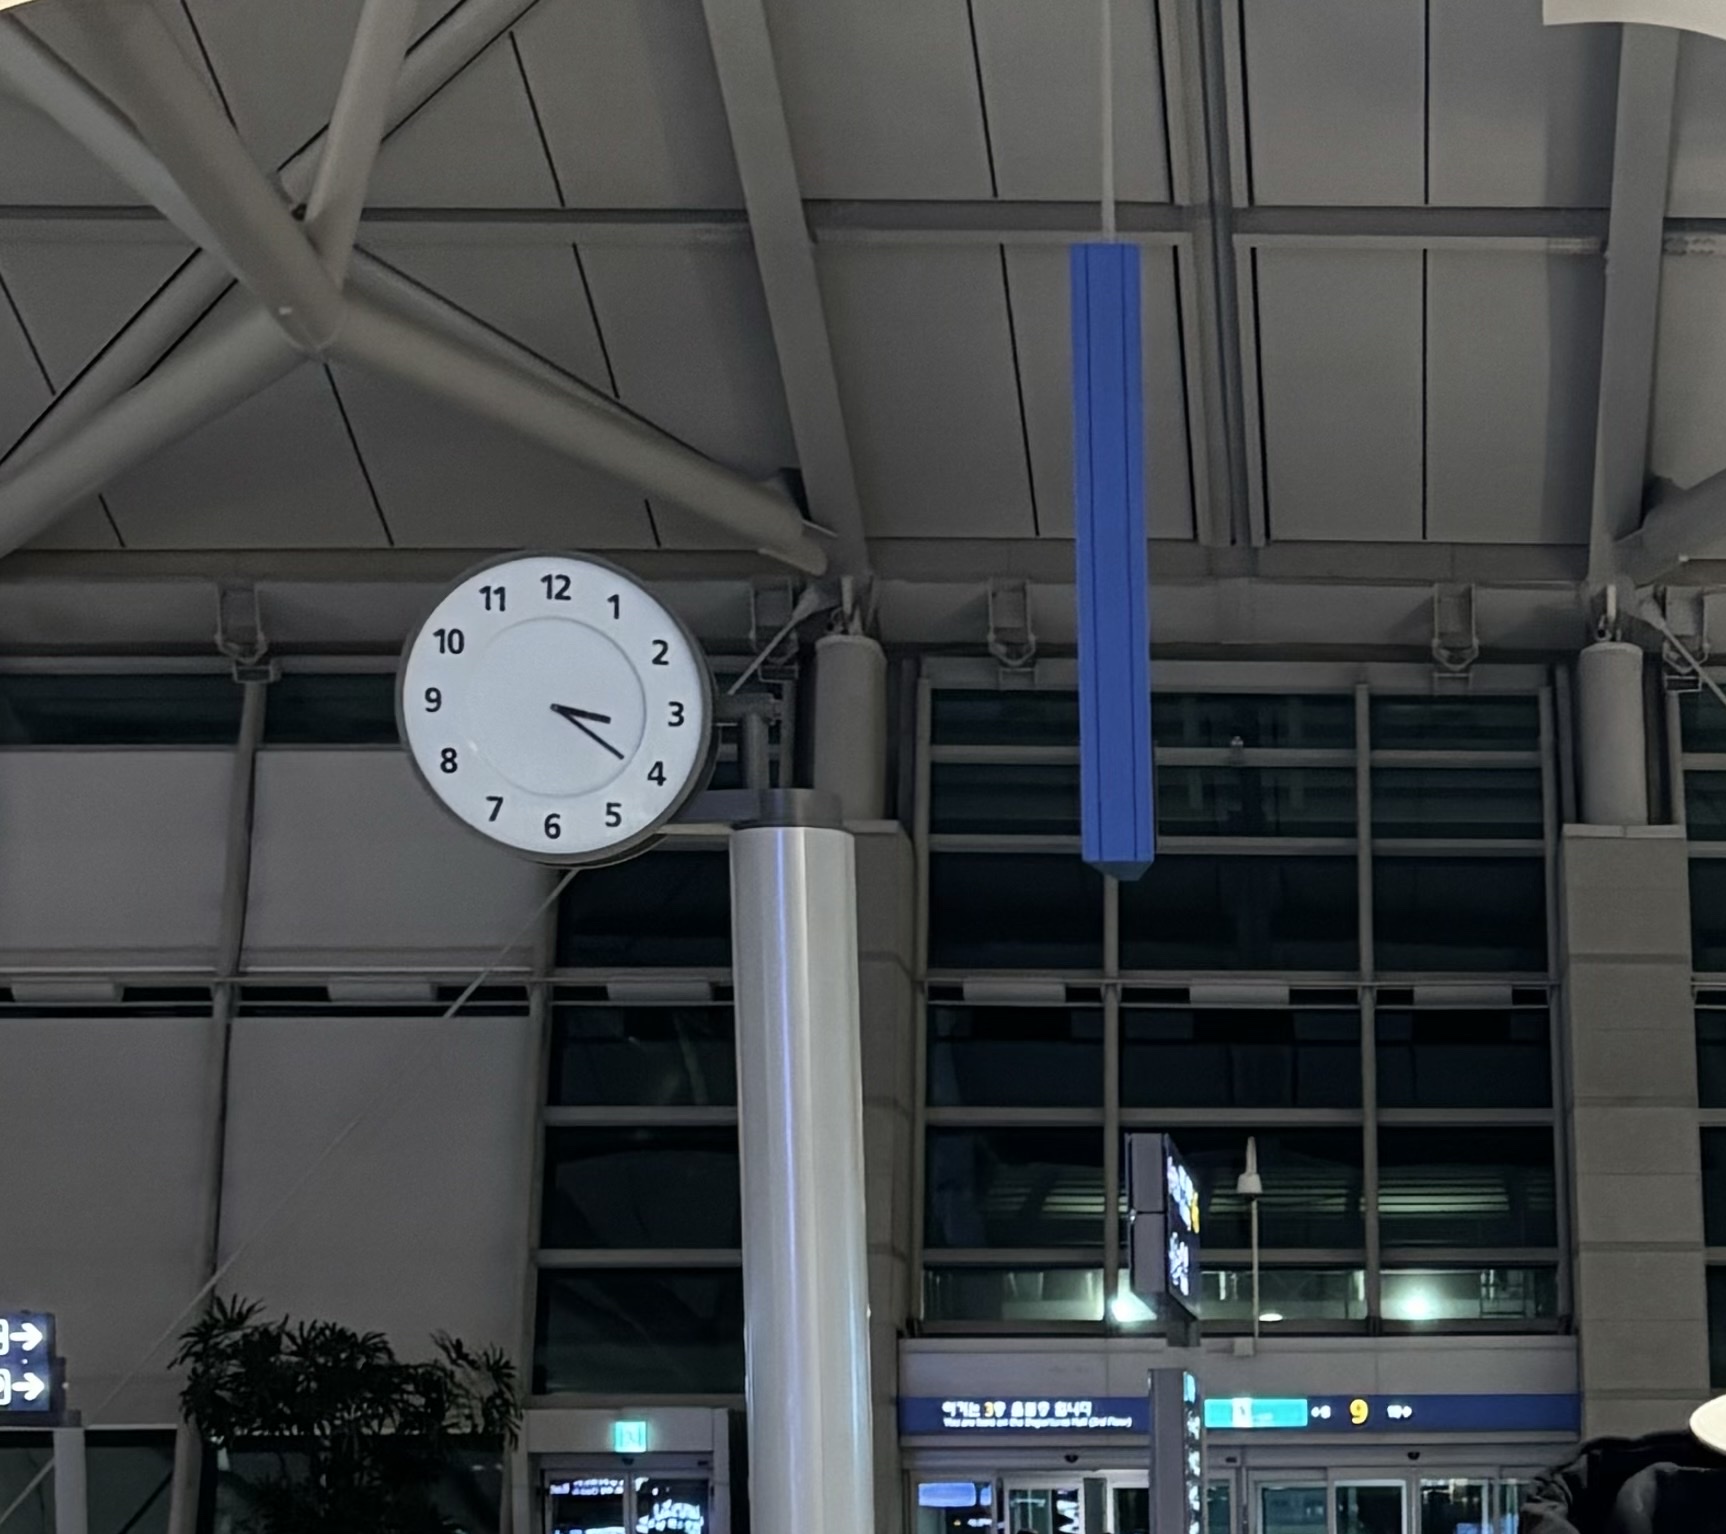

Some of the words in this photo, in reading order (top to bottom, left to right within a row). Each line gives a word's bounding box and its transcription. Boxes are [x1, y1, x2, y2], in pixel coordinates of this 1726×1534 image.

[479, 585, 506, 612] 11
[540, 574, 572, 601] 12
[607, 594, 620, 620] 1
[432, 628, 465, 655] 10
[651, 639, 669, 666] 2
[424, 687, 442, 713] 9
[667, 701, 685, 728] 3
[440, 747, 458, 774] 8
[647, 760, 667, 787] 4
[486, 795, 504, 822] 7
[605, 802, 622, 828] 5
[544, 813, 561, 840] 6
[1349, 1398, 1369, 1425] 9
